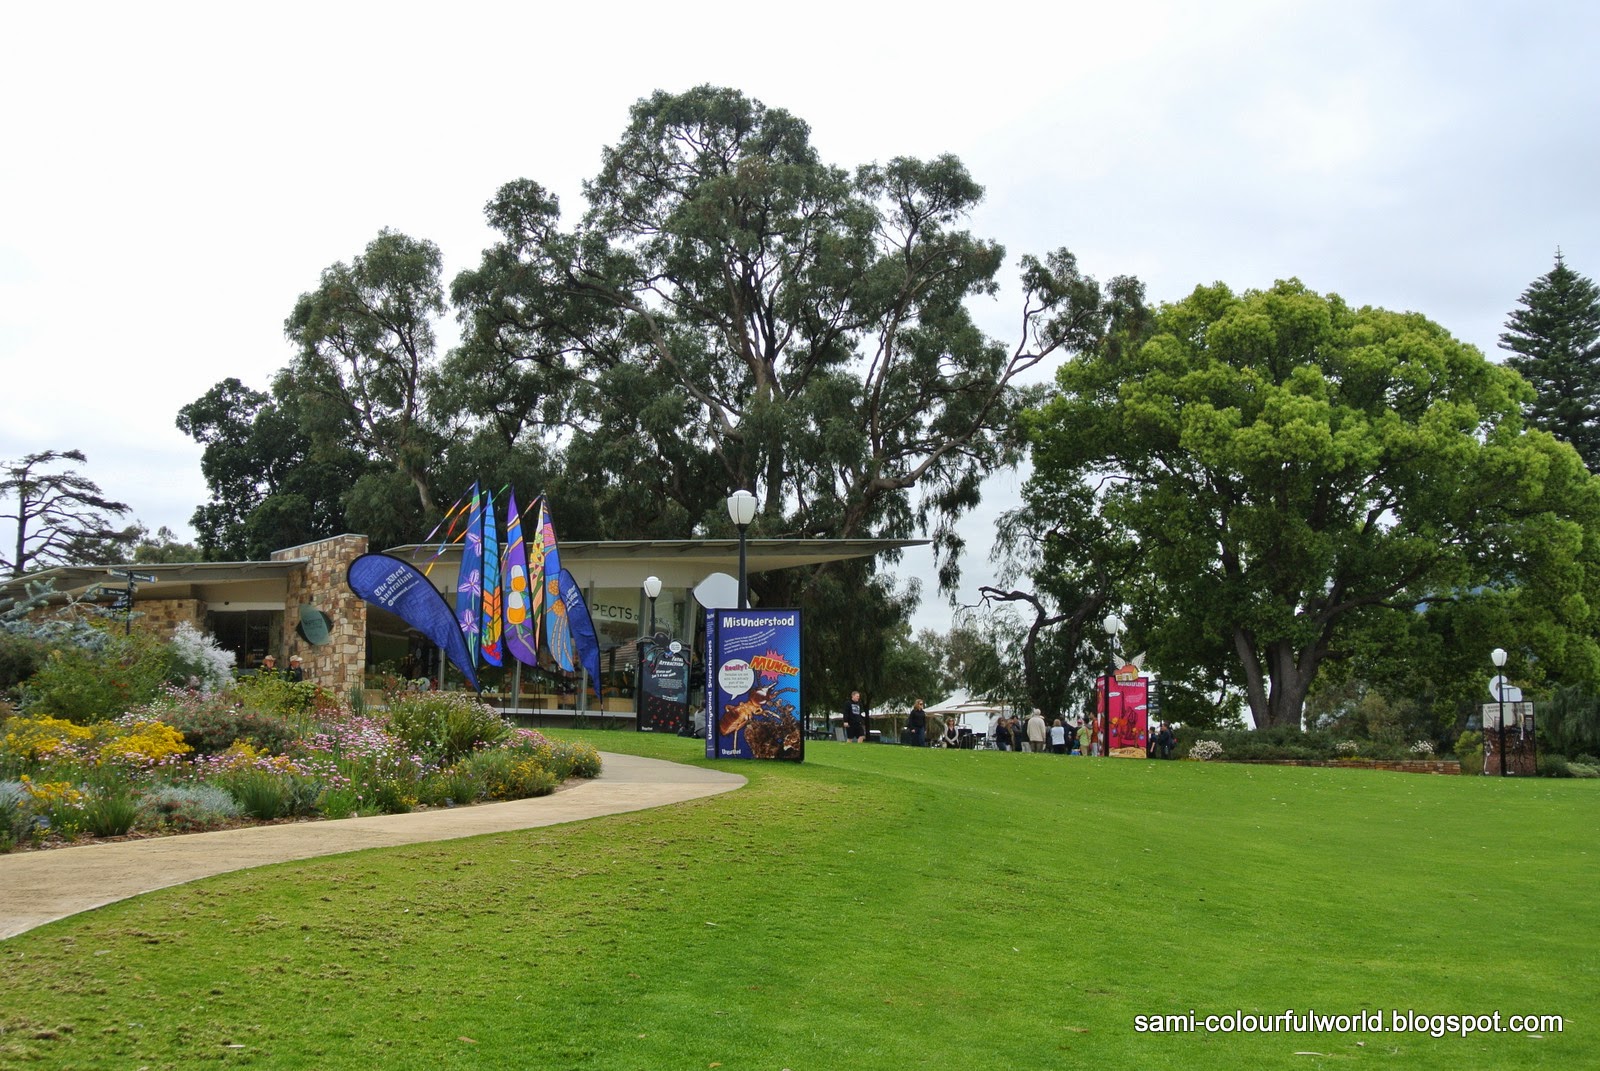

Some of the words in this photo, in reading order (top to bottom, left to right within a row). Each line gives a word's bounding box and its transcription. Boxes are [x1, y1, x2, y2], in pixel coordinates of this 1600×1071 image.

[374, 583, 387, 597] The
[386, 565, 406, 585] West
[378, 572, 413, 604] Australian
[724, 664, 747, 672] Really?
[750, 656, 799, 675] MUNCH!
